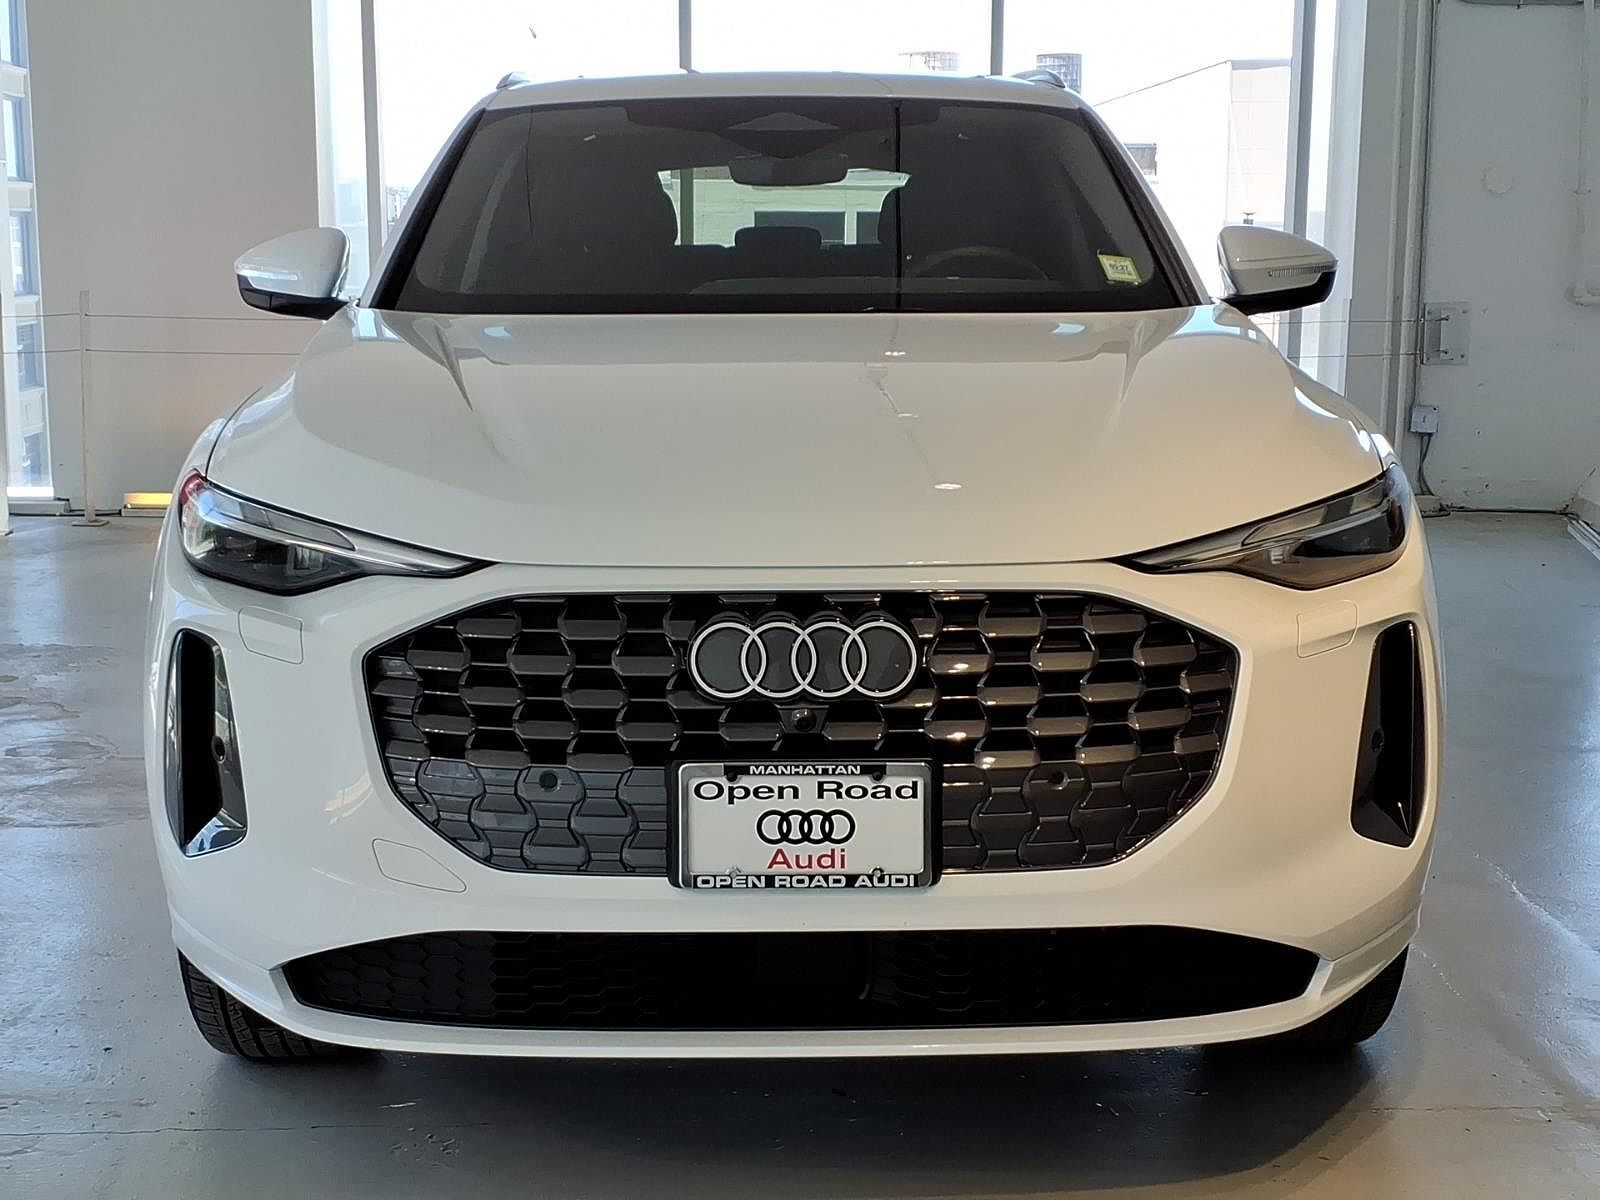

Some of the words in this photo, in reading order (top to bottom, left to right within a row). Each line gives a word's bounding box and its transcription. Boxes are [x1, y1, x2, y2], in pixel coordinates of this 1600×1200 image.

[750, 765, 860, 775] MANHATTAN
[694, 780, 800, 804] Open
[817, 780, 918, 799] Road
[767, 848, 846, 869] Audi
[696, 876, 765, 888] OPEN
[774, 876, 846, 888] ROAD
[854, 876, 915, 887] AUDI
